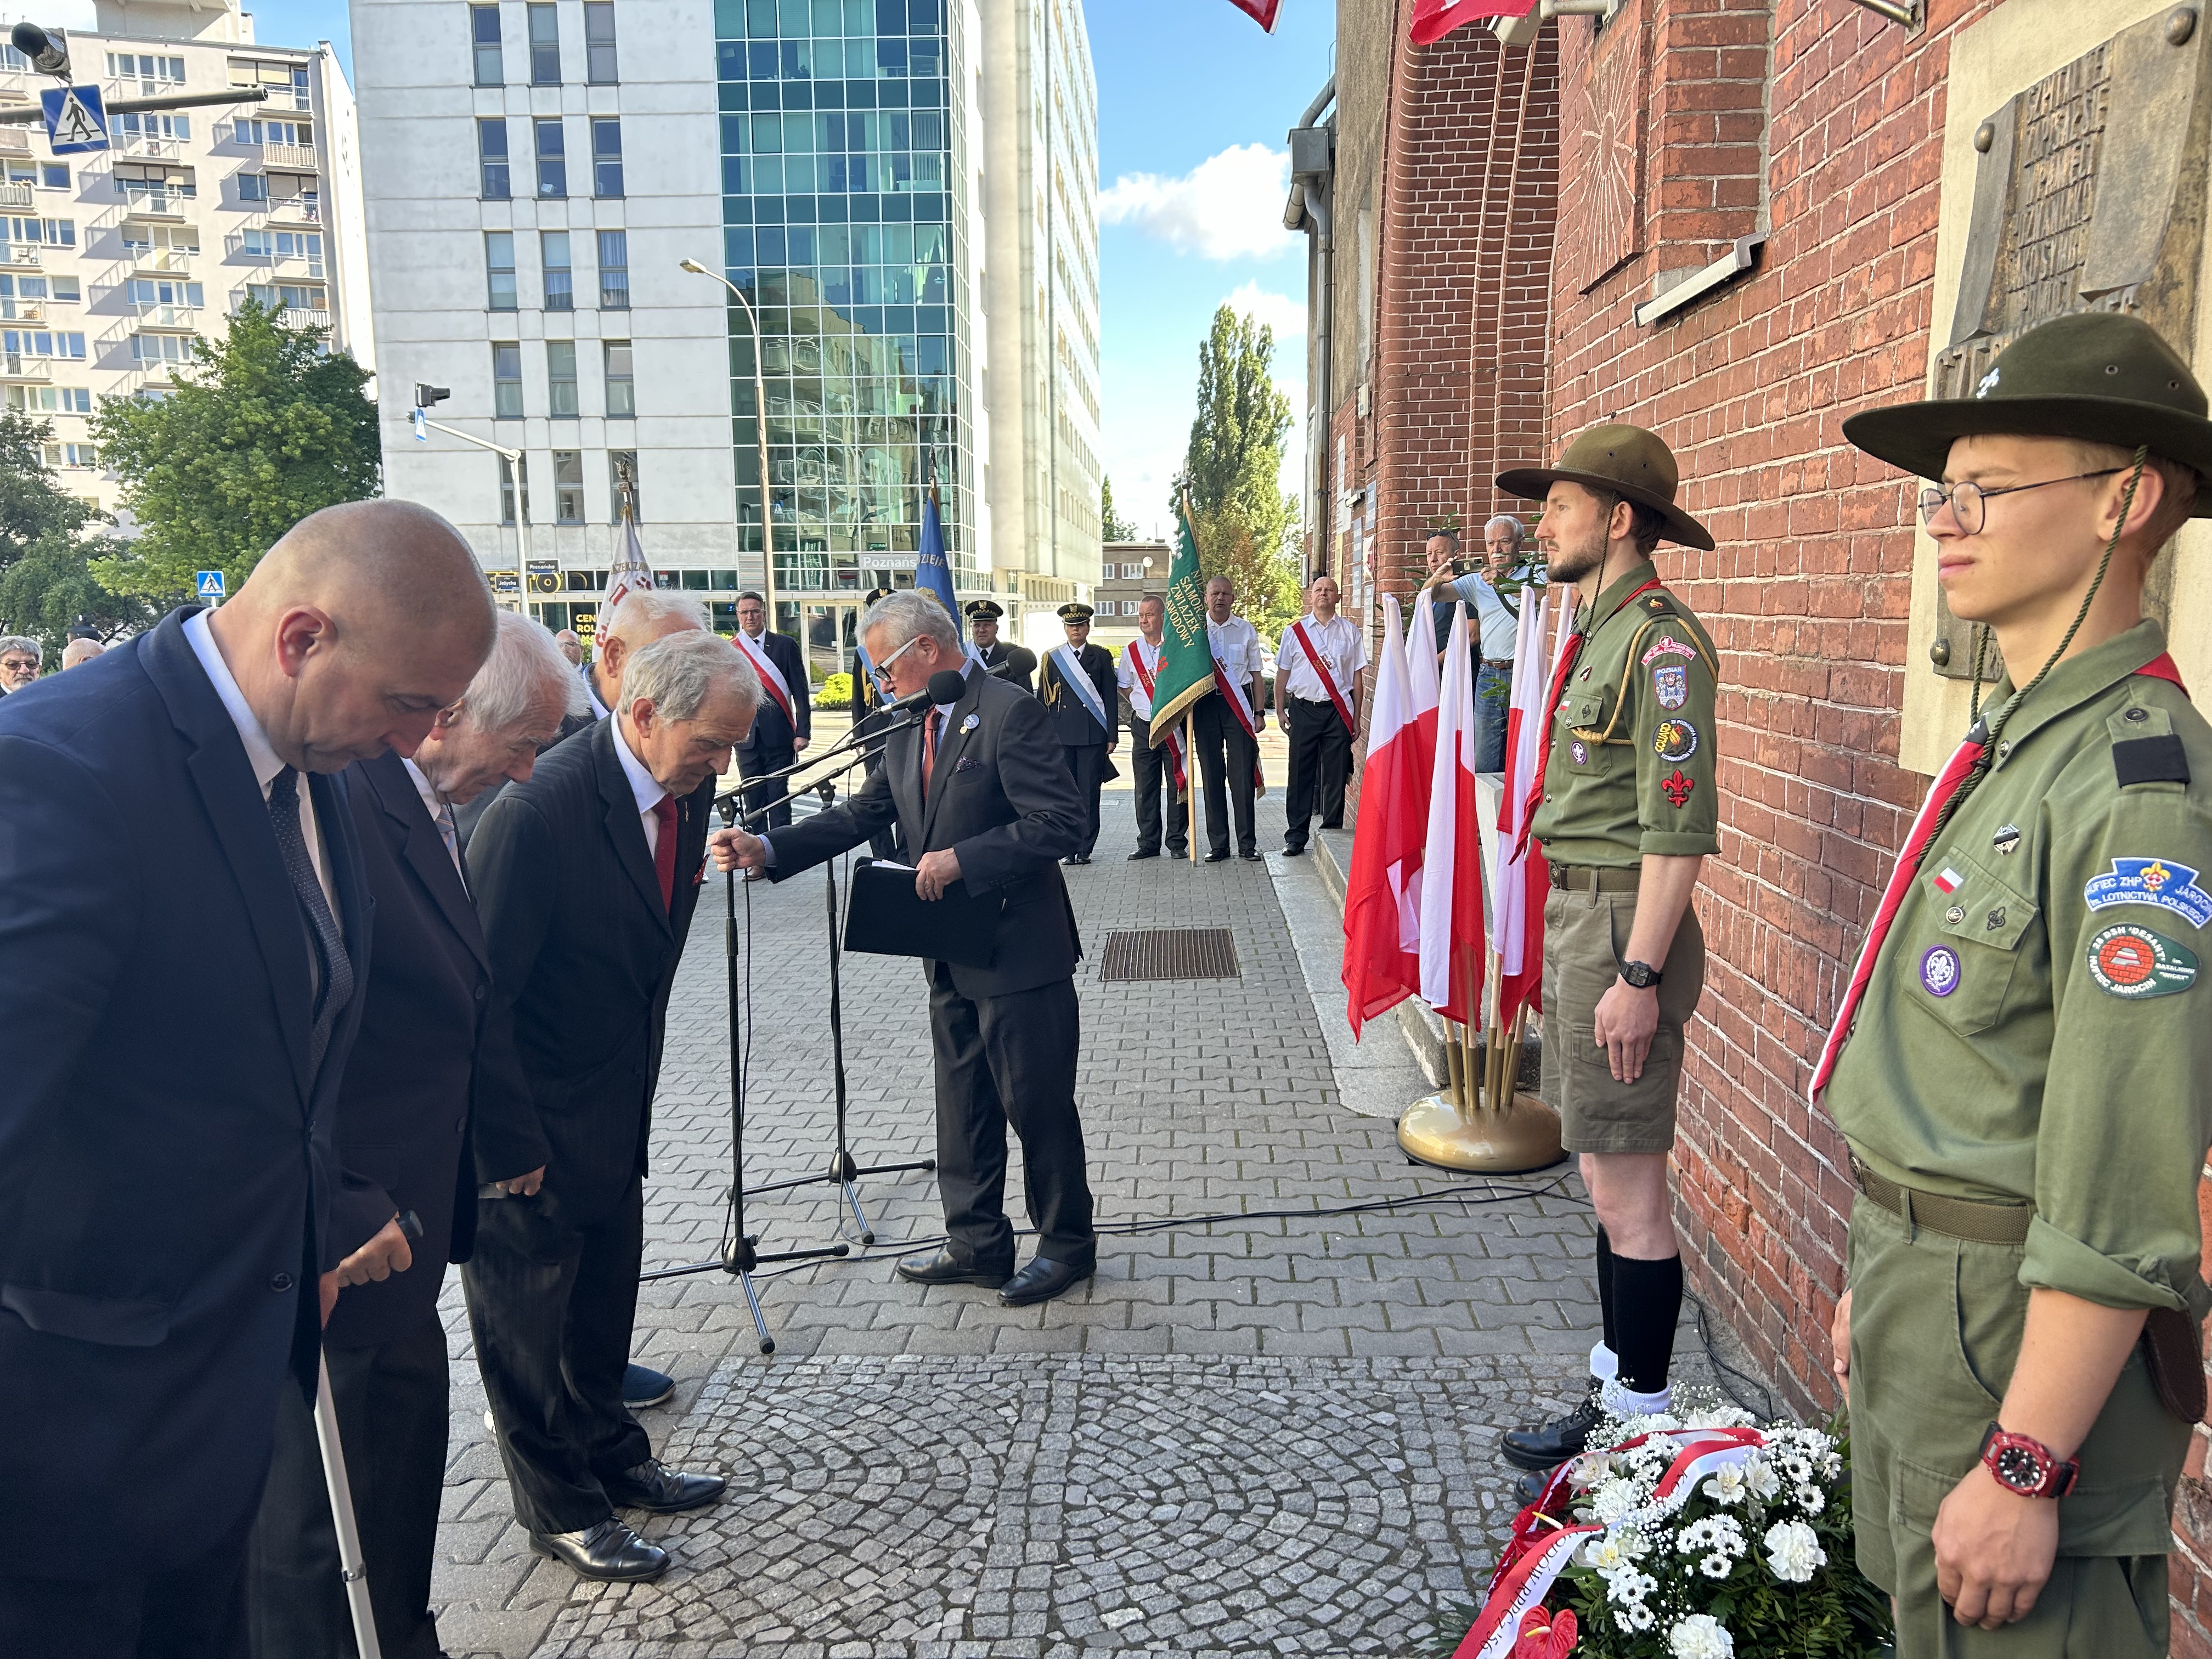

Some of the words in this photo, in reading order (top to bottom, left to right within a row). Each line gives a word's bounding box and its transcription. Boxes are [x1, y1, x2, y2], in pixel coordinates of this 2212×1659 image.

[862, 556, 917, 567] Poznańs
[576, 614, 596, 623] CEN
[1166, 591, 1195, 648] ZAWODOWY
[577, 624, 596, 633] ROL
[2086, 878, 2117, 895] HUFIEC
[2119, 876, 2143, 886] ZHP
[2102, 891, 2158, 902] LOTNICTWA
[2103, 926, 2126, 939] DSH
[2089, 955, 2111, 986] HUFIEC
[2110, 978, 2157, 994] JAROCIN
[1527, 1531, 1578, 1585] ODÓW
